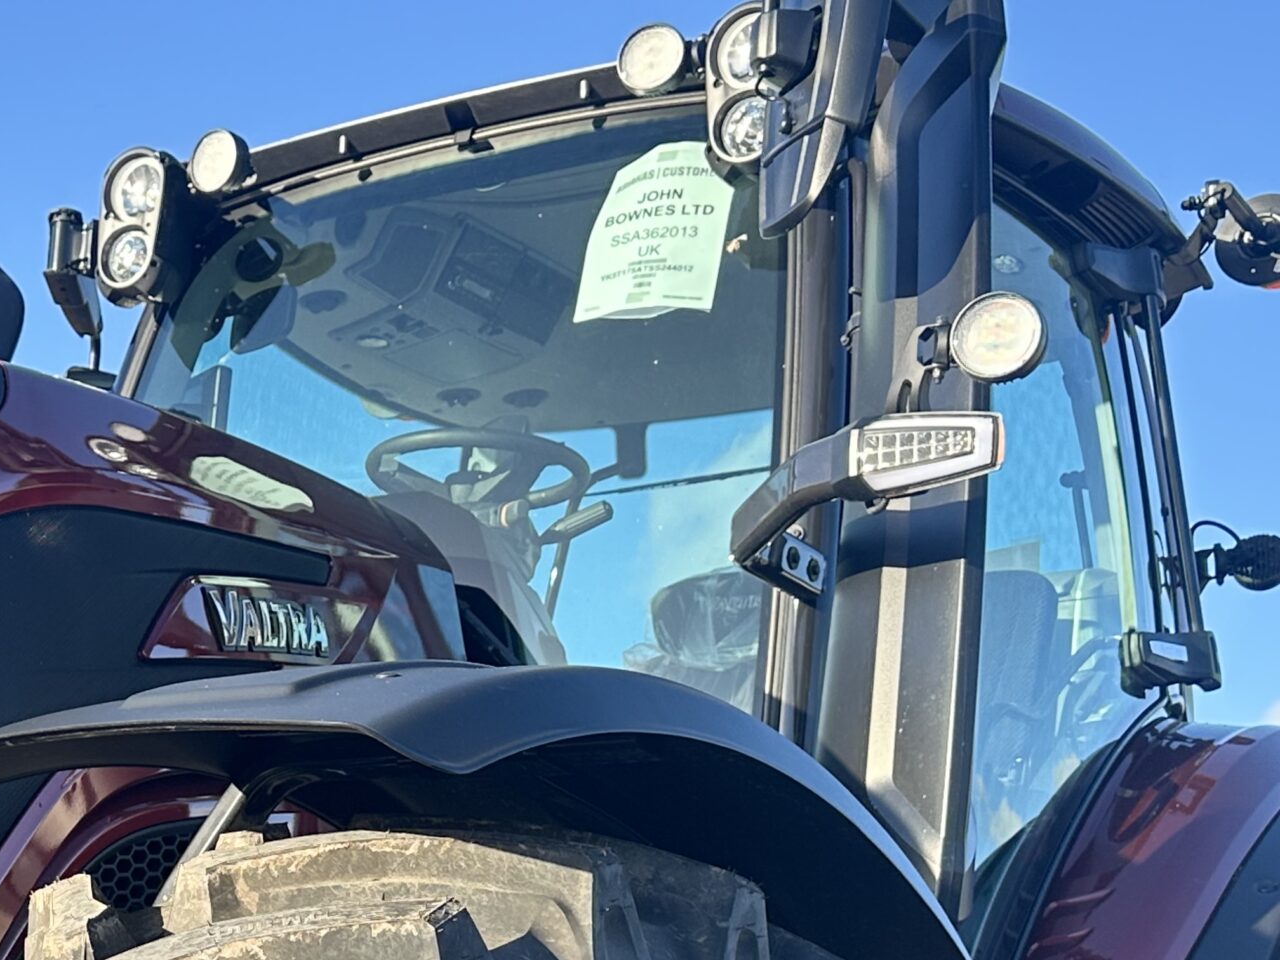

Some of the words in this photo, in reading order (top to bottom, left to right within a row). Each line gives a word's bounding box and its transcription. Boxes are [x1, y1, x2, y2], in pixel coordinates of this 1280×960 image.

[637, 189, 683, 204] JOHN
[605, 205, 675, 228] BOWNES
[681, 204, 715, 216] LTD
[611, 227, 698, 246] SSA362013
[638, 246, 660, 257] UK
[206, 588, 329, 655] VALTRA
